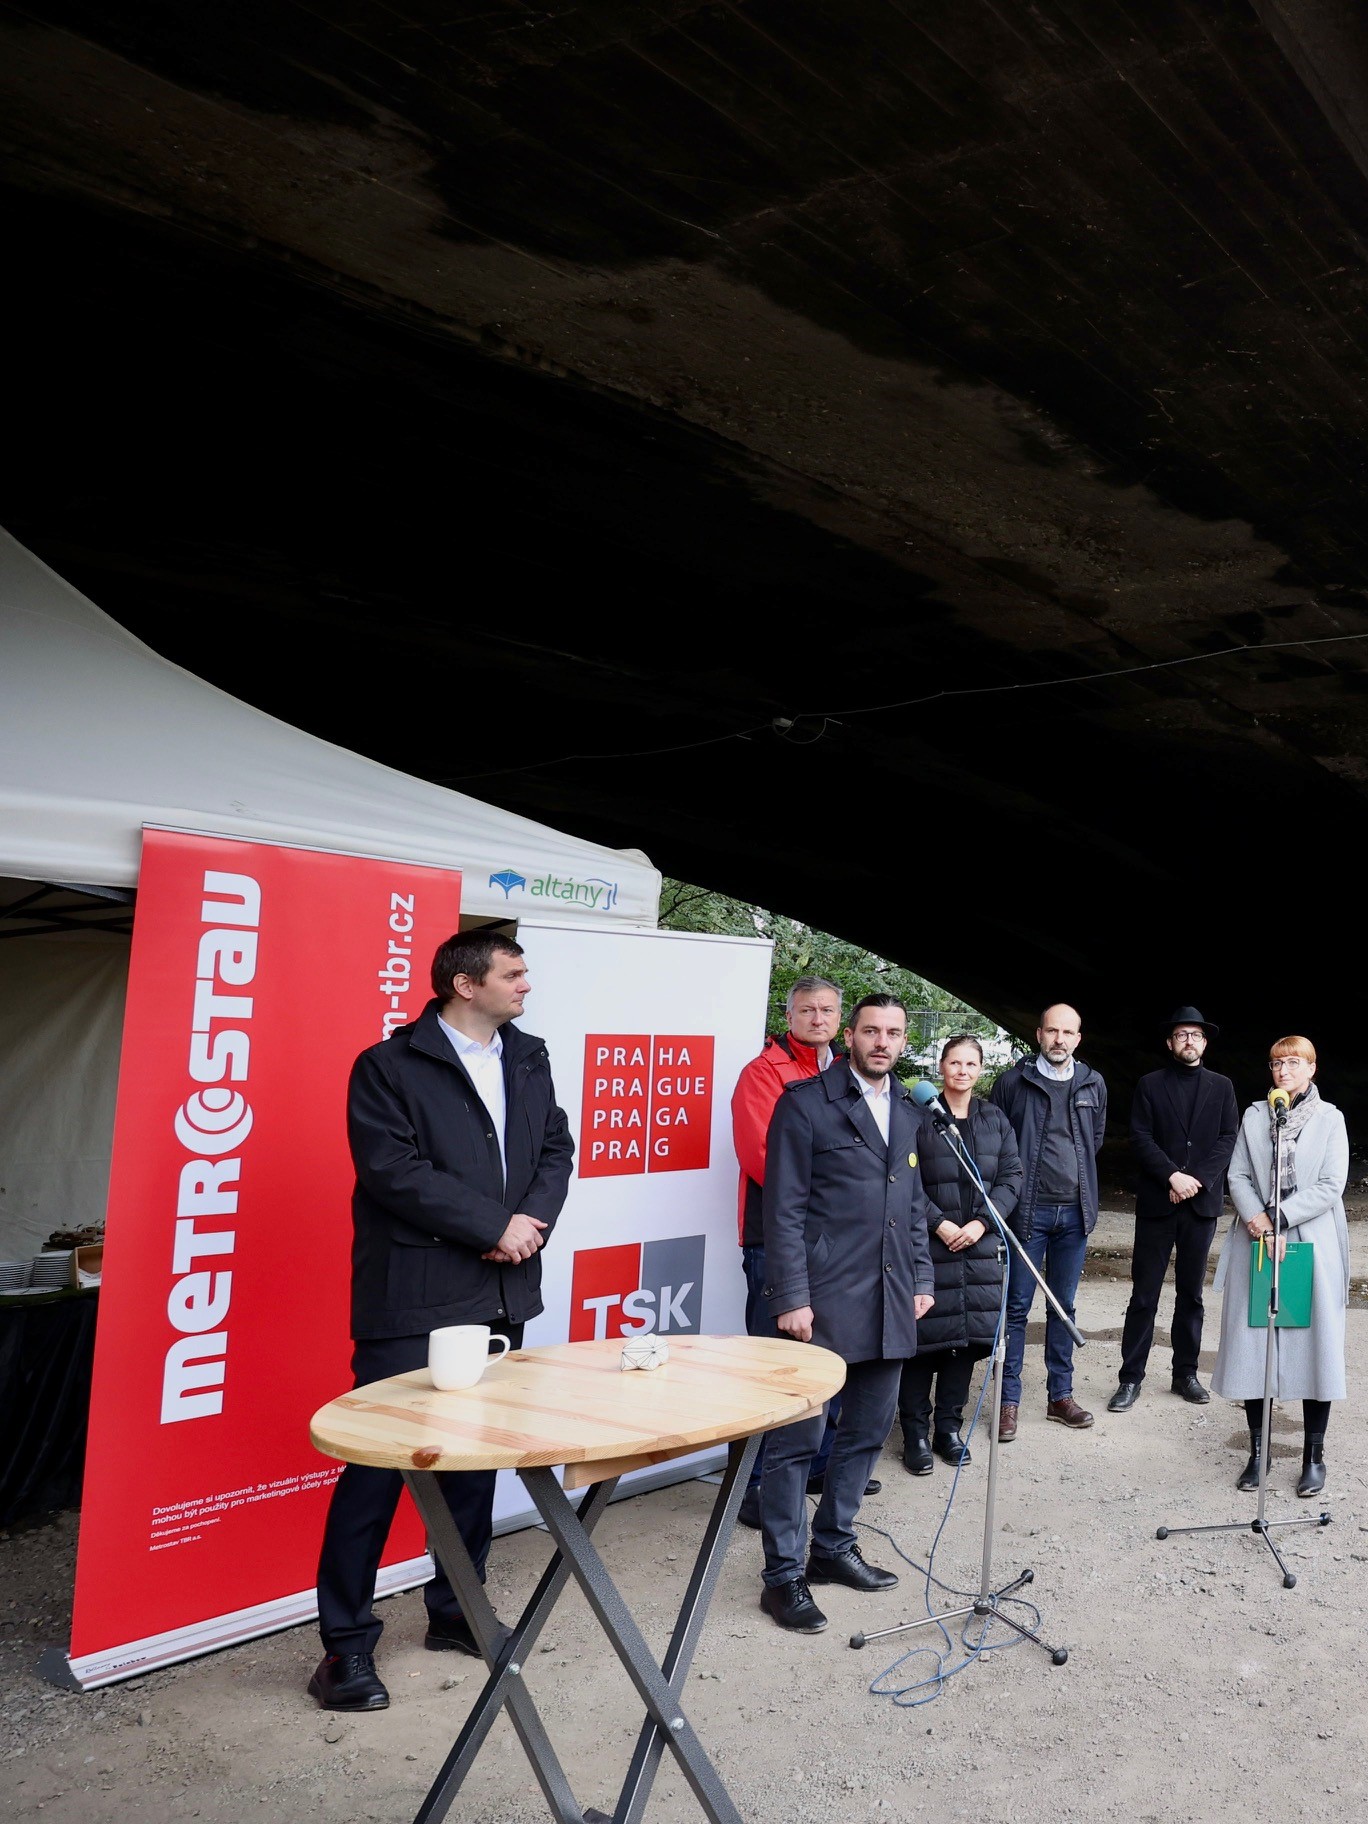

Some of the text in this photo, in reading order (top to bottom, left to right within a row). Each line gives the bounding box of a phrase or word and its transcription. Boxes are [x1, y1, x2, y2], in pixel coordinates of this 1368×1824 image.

[530, 874, 604, 908] altány
[583, 1282, 694, 1341] TSK
[152, 1513, 182, 1526] mohou
[184, 1508, 197, 1519] být
[199, 1502, 229, 1516] použity
[231, 1498, 245, 1508] pro
[246, 1485, 300, 1503] marketingové
[302, 1480, 321, 1491] účely
[153, 1499, 203, 1516] Dovolujeme
[206, 1495, 214, 1503] si
[257, 1483, 267, 1492] že
[269, 1476, 298, 1489] vizuální
[300, 1469, 330, 1483] výstupy
